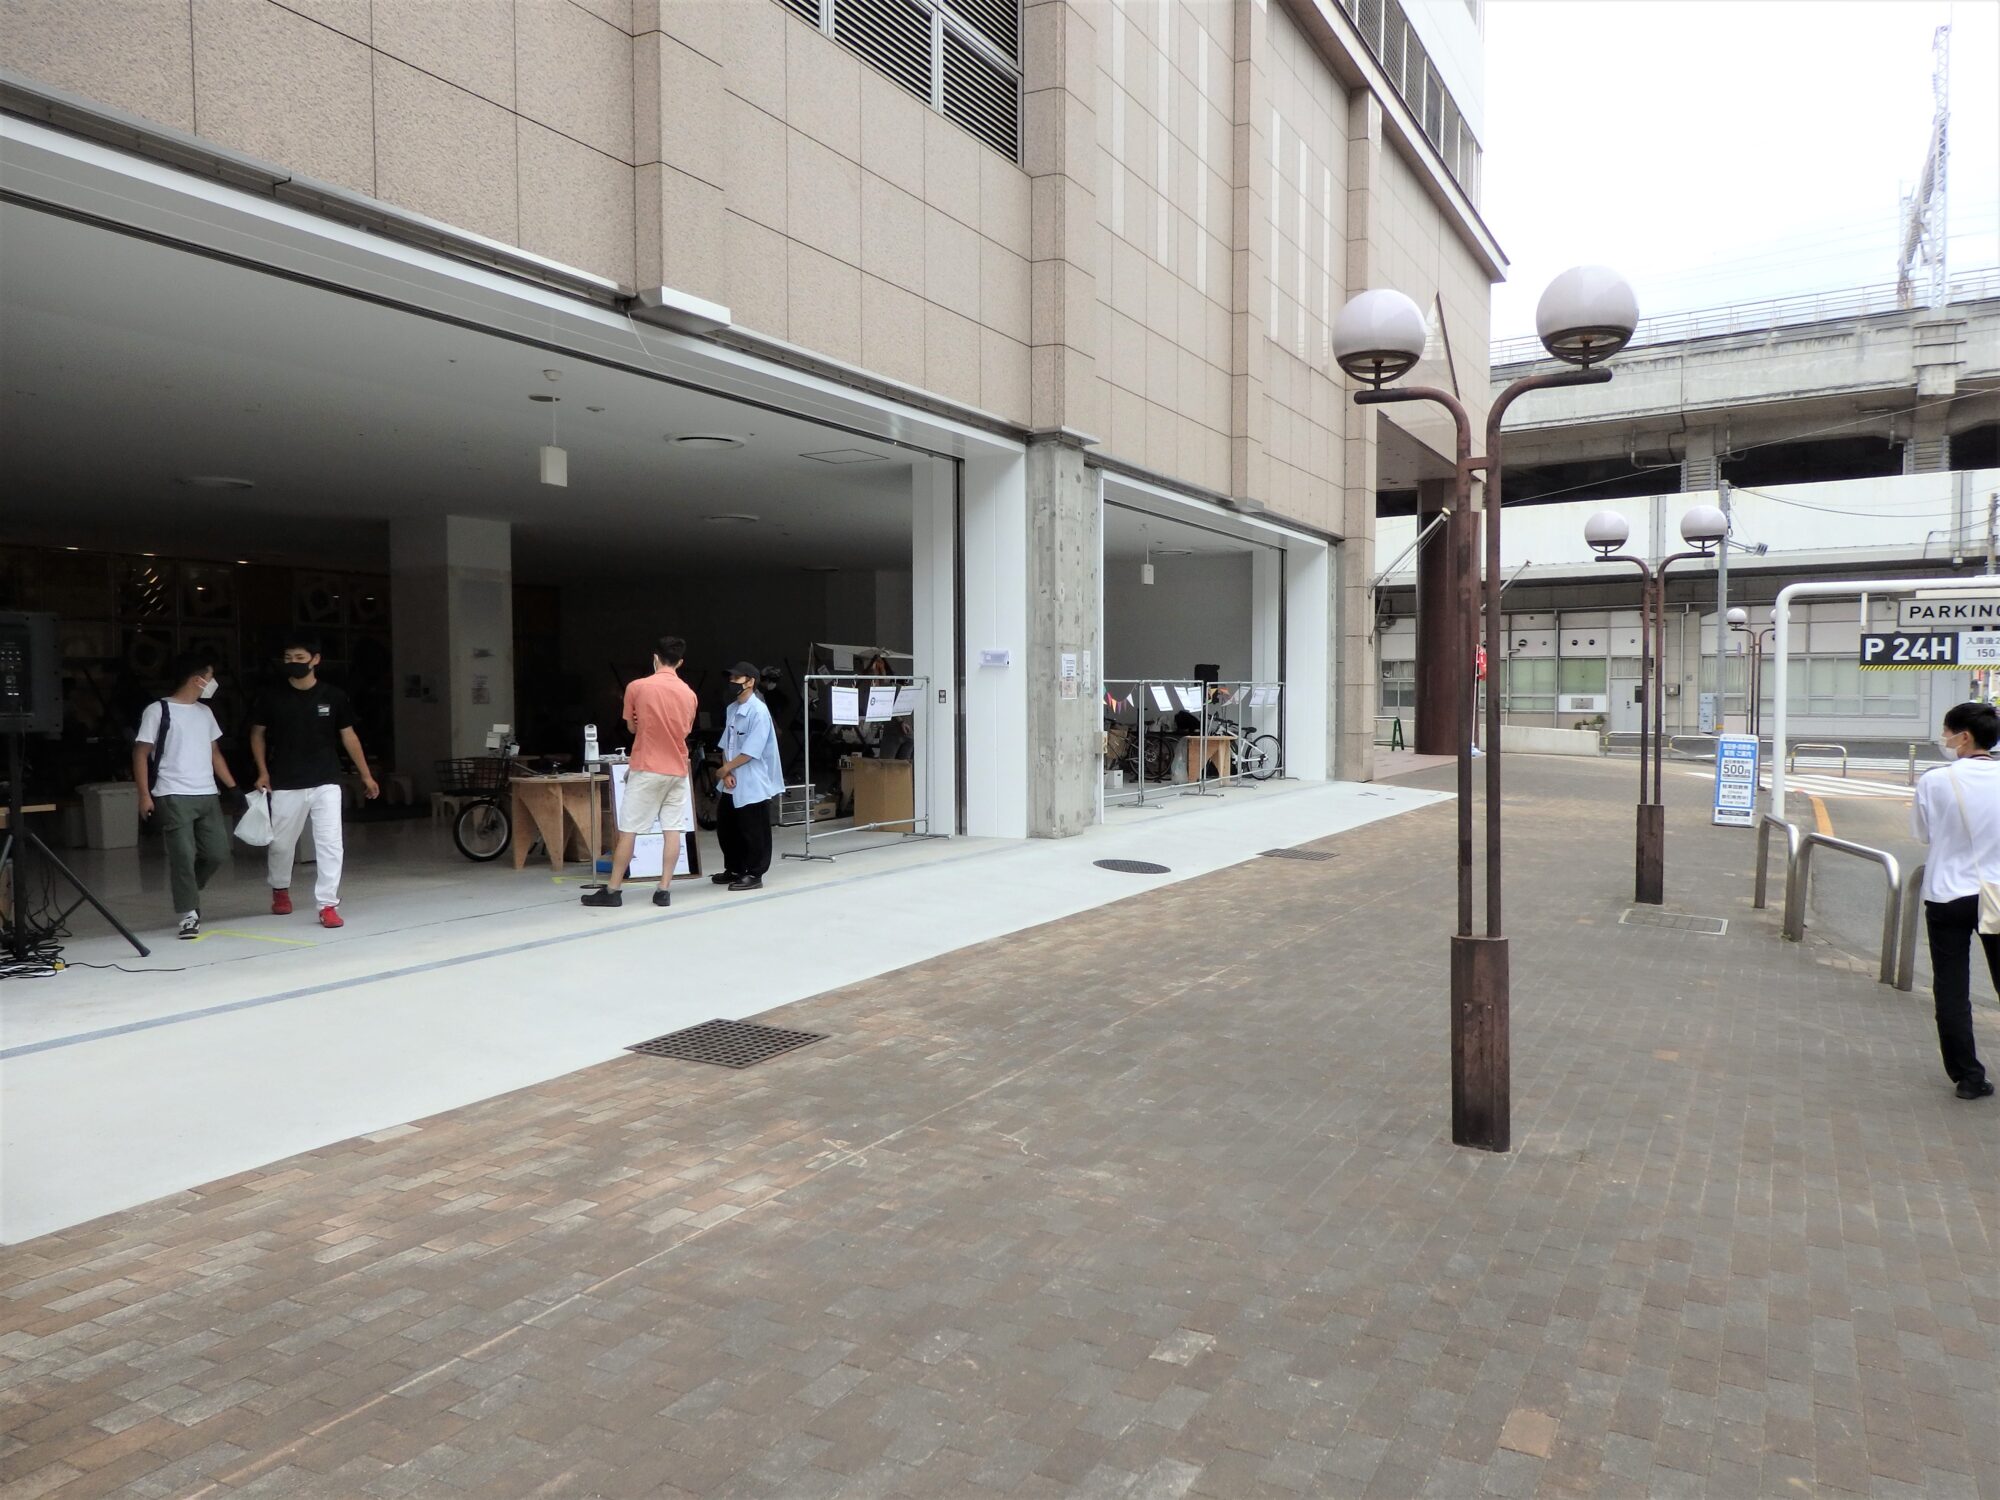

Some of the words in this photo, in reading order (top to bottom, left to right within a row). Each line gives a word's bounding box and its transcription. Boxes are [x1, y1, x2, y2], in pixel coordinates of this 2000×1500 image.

[1865, 638, 1885, 661] P
[1892, 637, 1952, 661] 24H
[1977, 648, 1996, 657] 150
